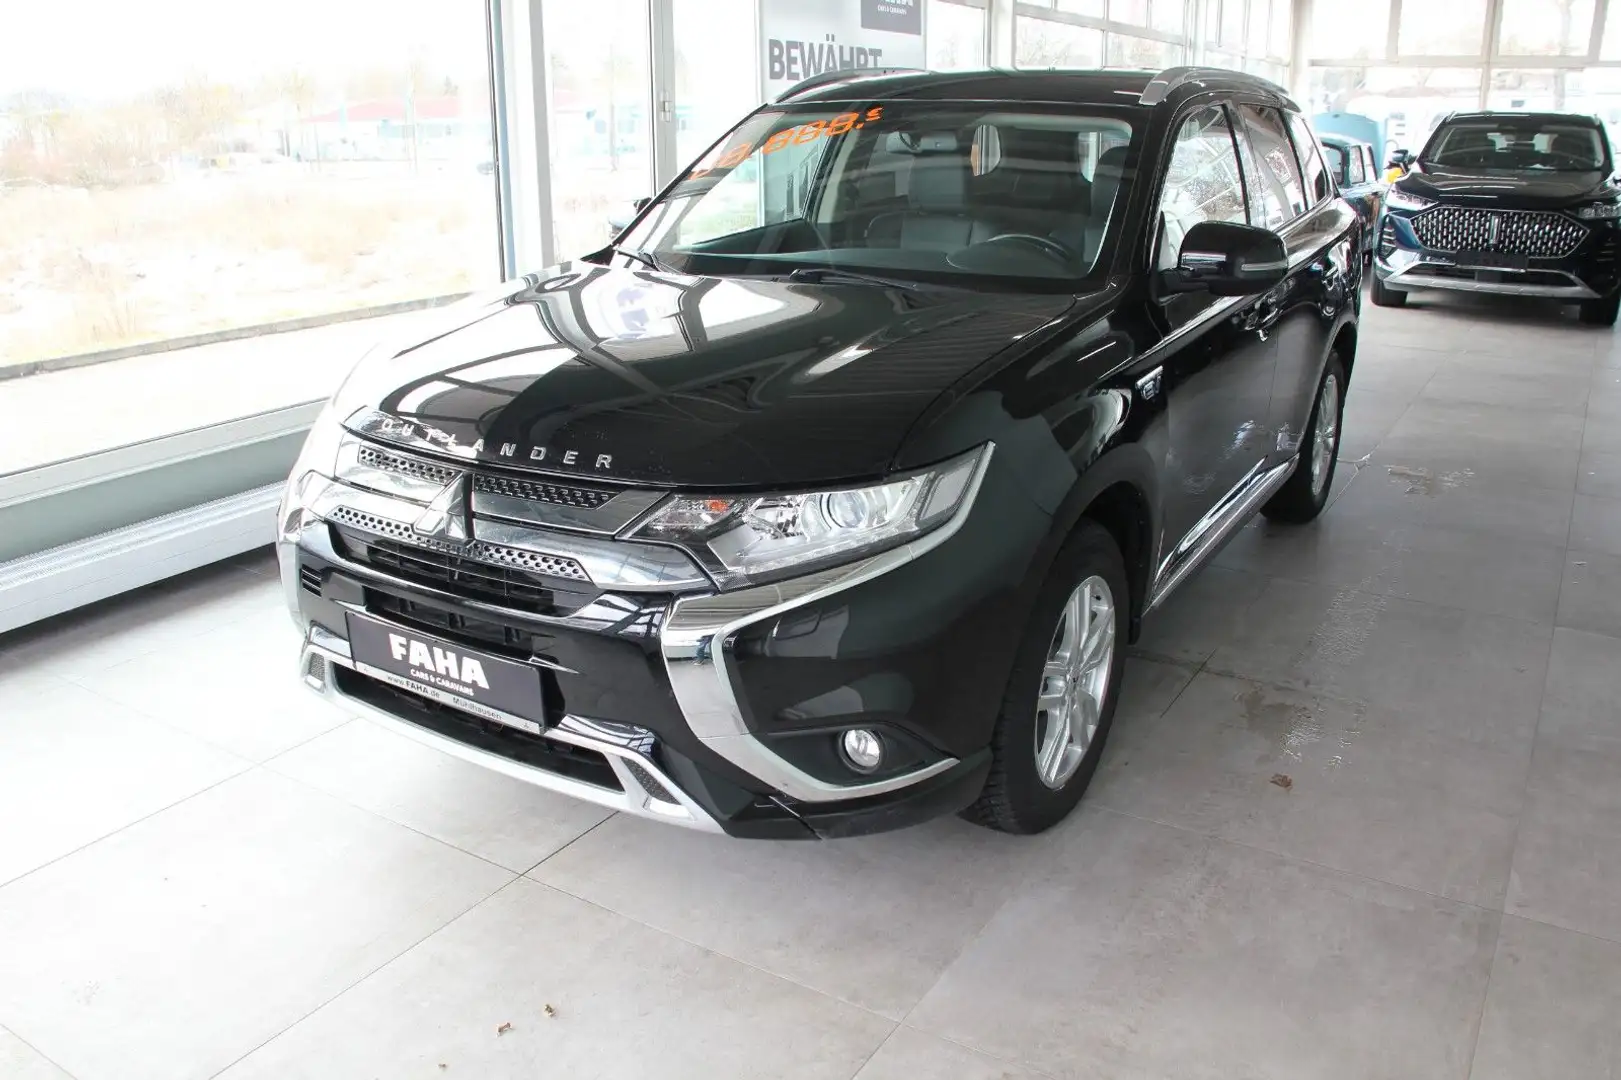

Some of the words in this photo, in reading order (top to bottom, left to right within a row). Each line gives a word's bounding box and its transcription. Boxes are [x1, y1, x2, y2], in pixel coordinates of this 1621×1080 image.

[768, 34, 882, 80] BEWÄHRT
[381, 418, 613, 469] OUTLANDER
[388, 633, 490, 690] FAHA
